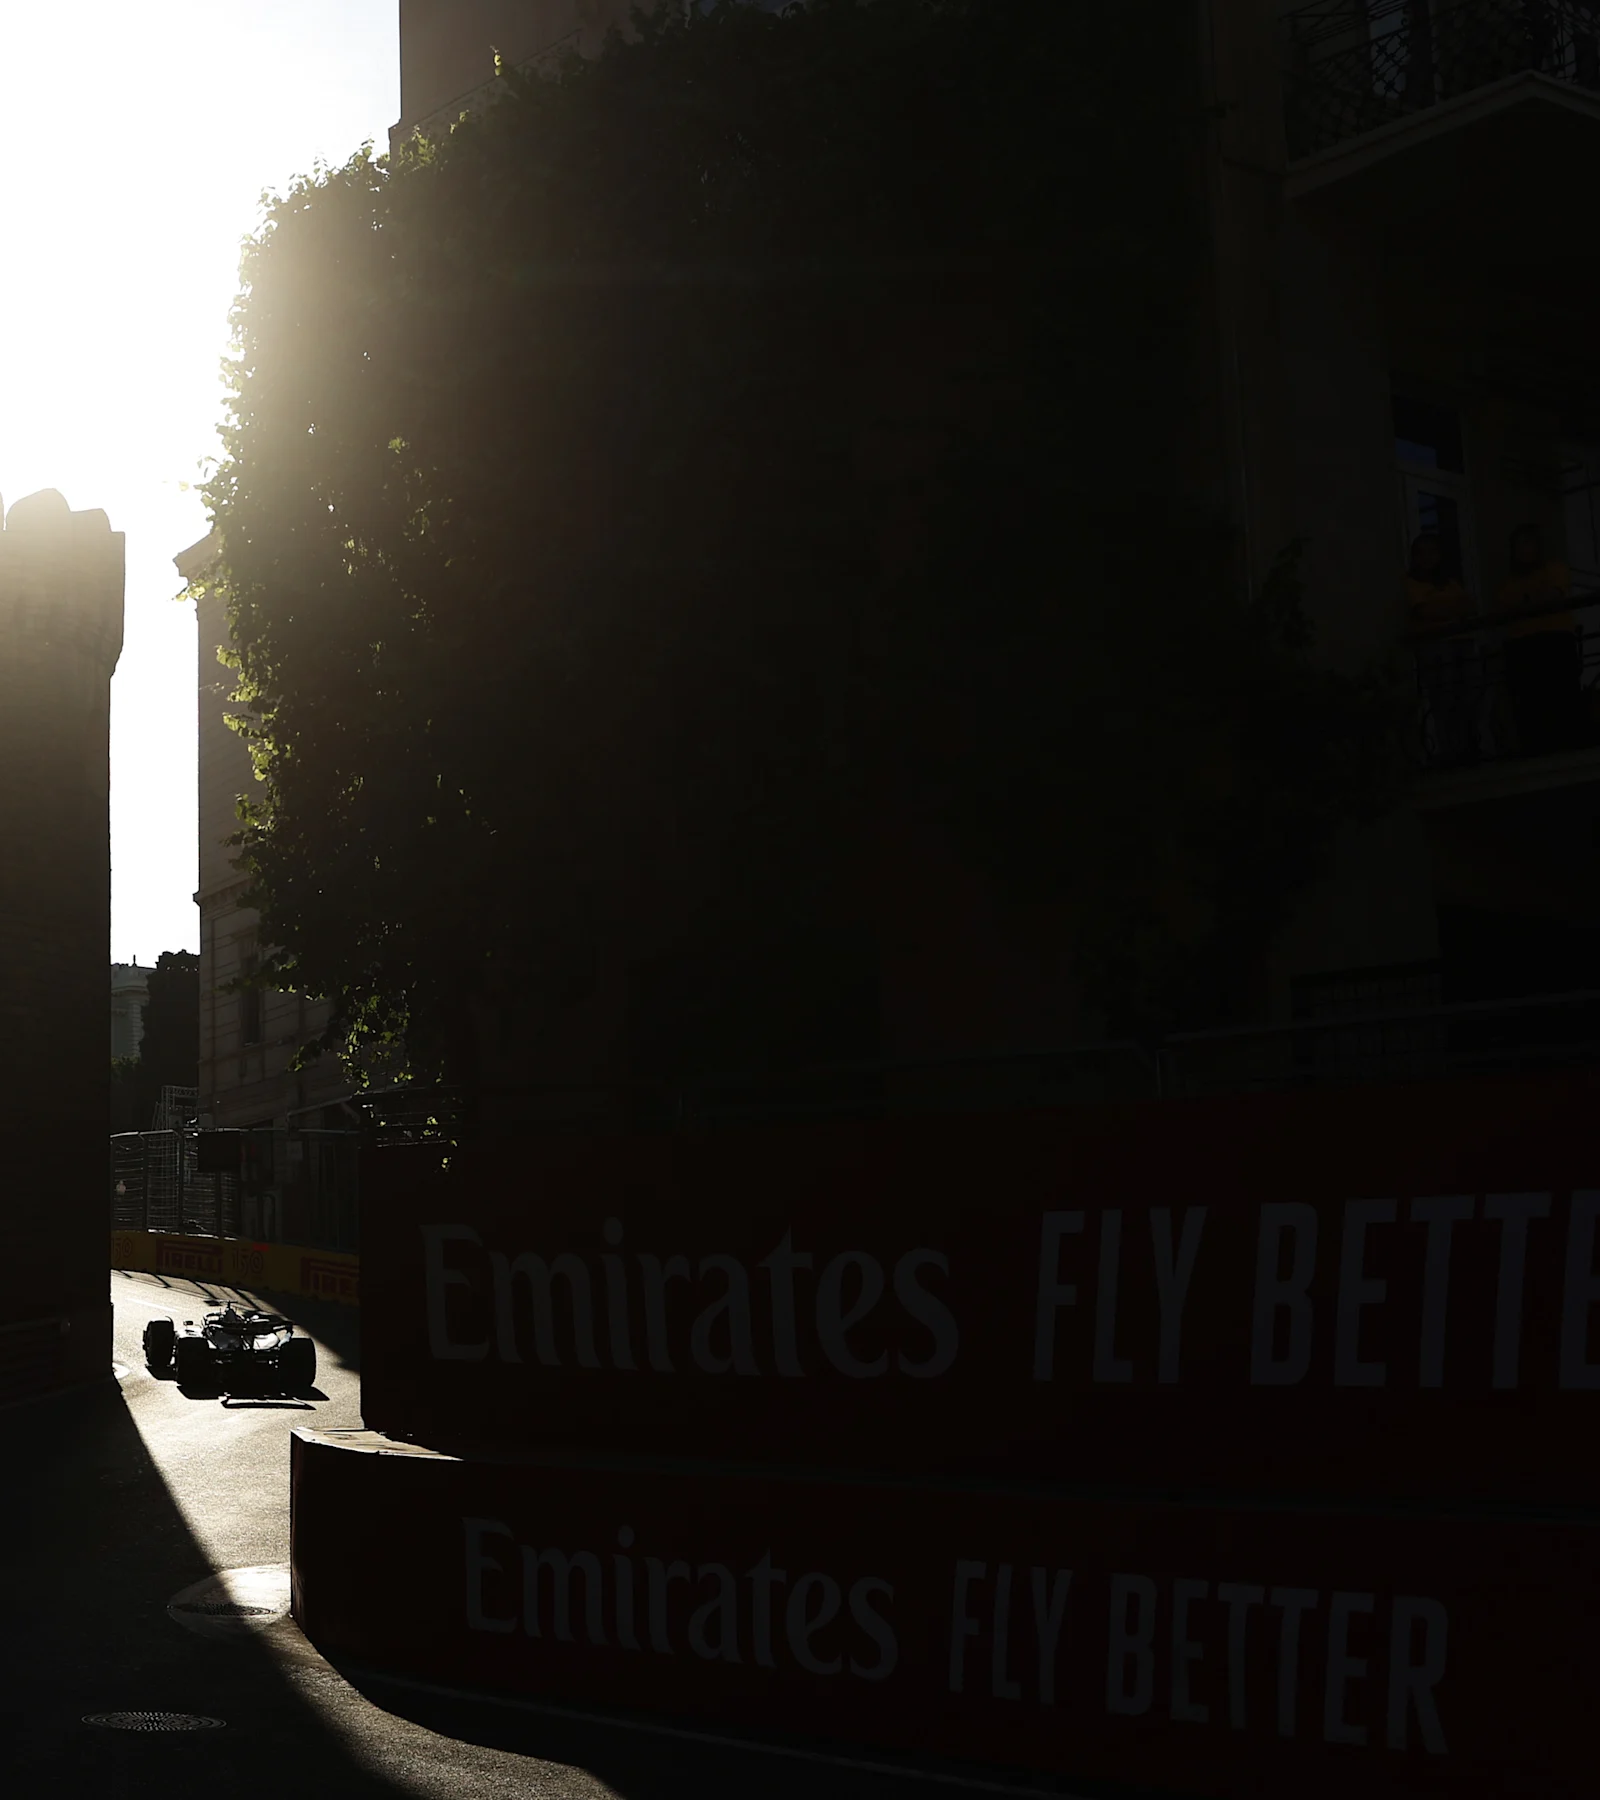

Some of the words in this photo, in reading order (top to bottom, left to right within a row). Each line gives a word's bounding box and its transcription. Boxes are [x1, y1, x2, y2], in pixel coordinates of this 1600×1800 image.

[156, 1238, 224, 1274] PIRELLI
[419, 1216, 960, 1379] Emirates
[1032, 1205, 1208, 1384] FLY
[462, 1517, 898, 1681] Emirates
[948, 1559, 1073, 1704] FLY
[1106, 1573, 1449, 1753] BETTER
